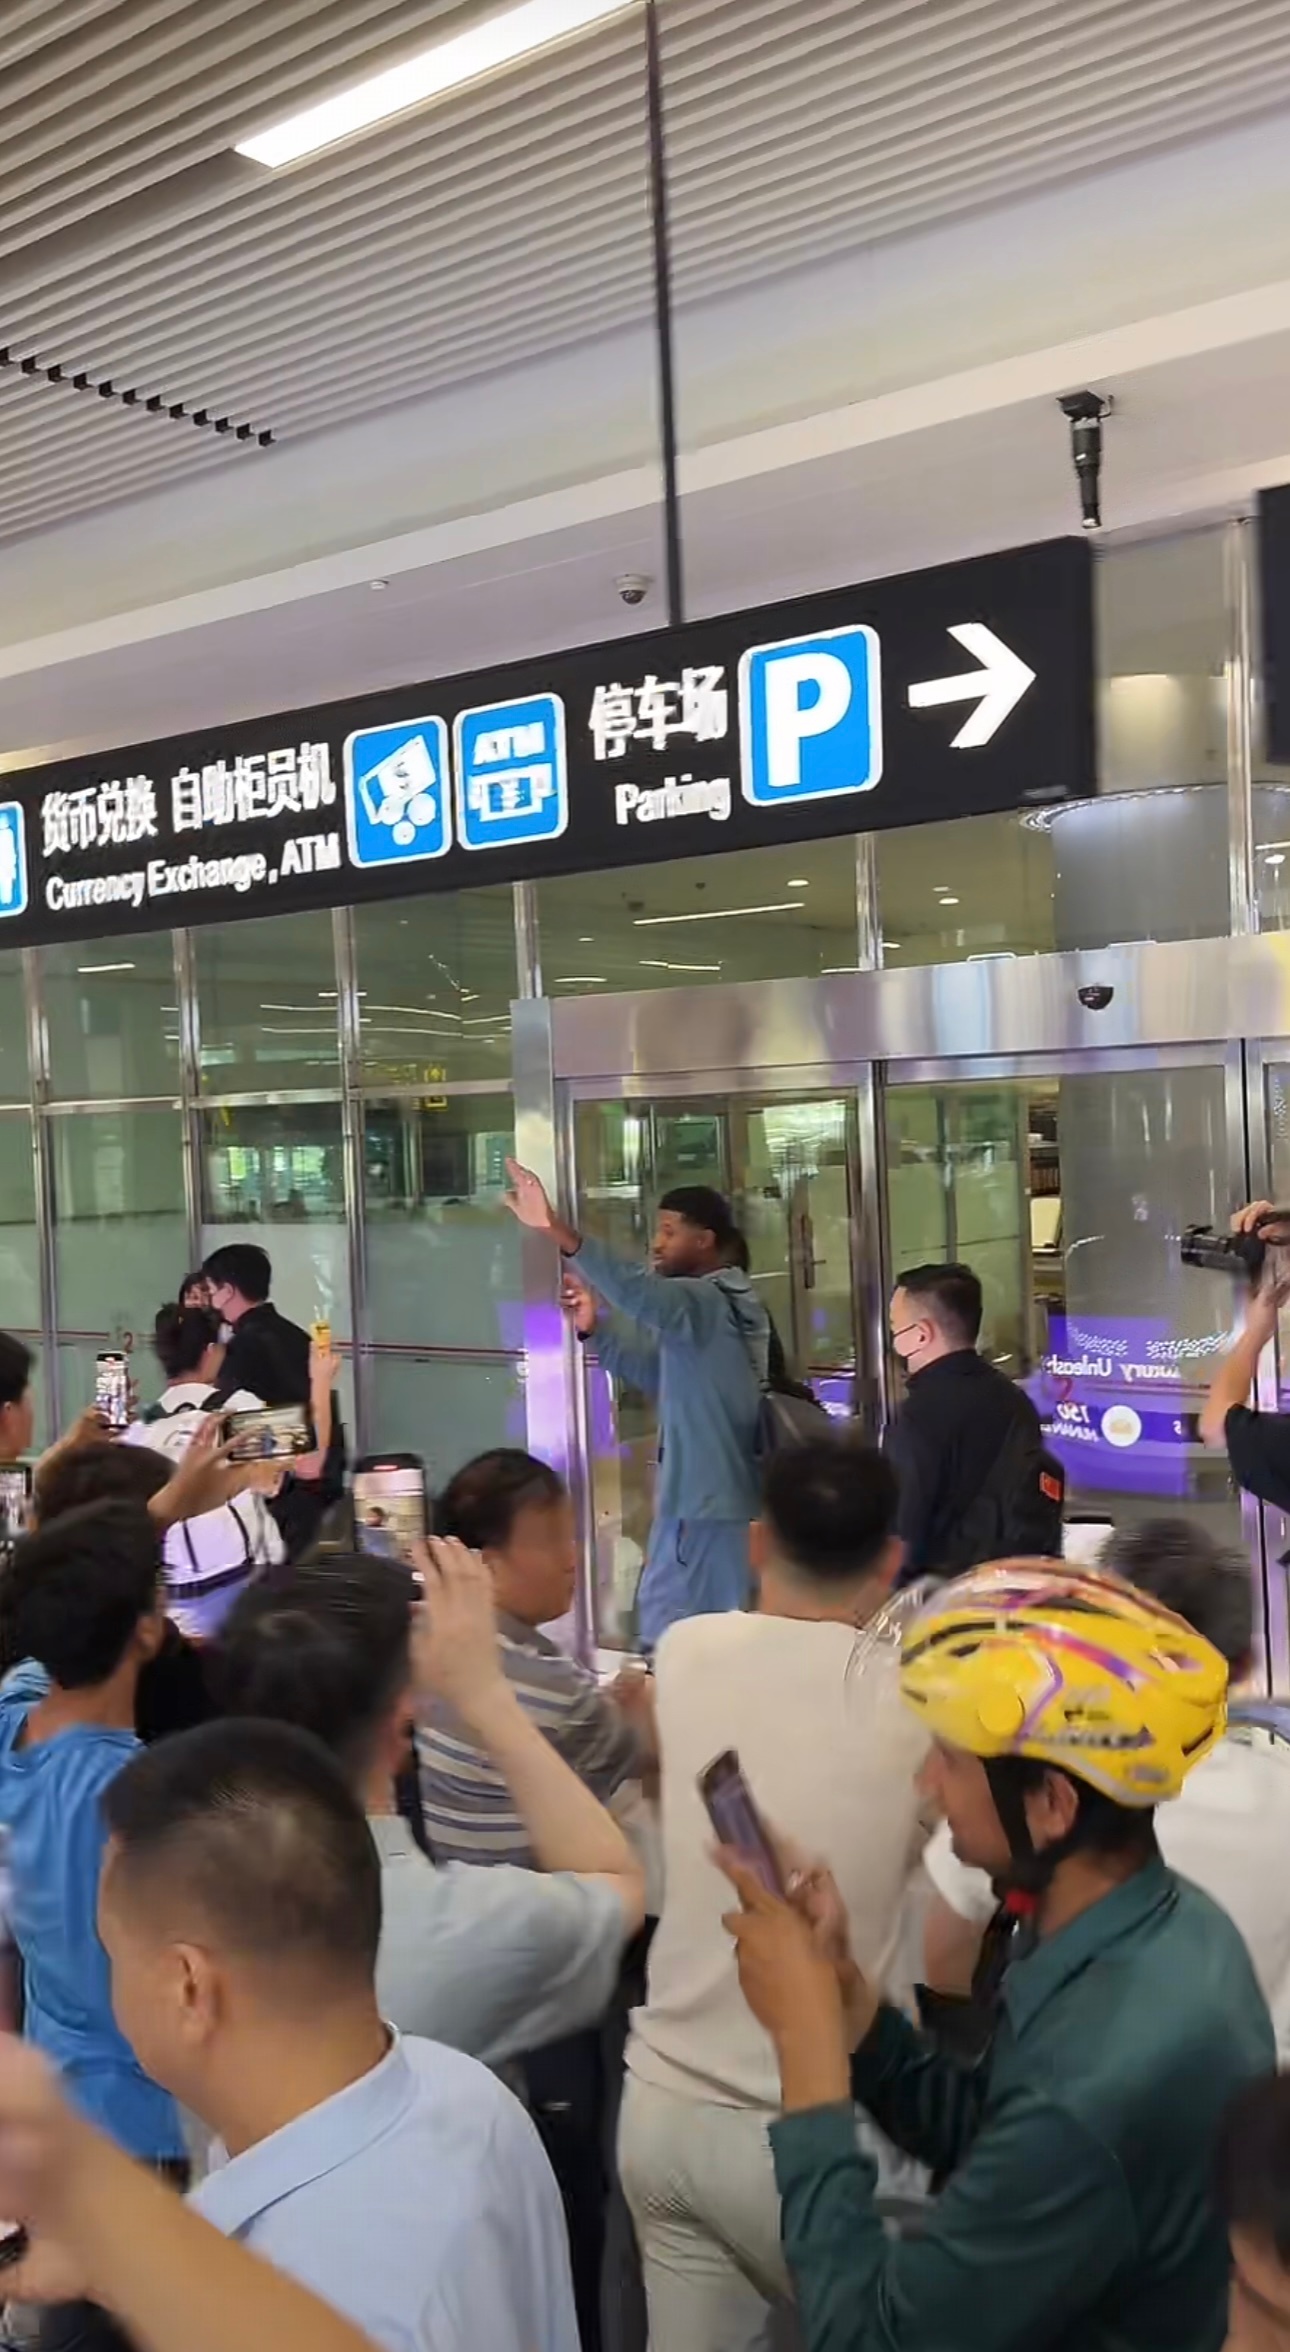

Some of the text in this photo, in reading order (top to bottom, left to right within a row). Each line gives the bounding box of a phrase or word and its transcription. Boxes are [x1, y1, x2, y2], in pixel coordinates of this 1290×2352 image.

[473, 721, 546, 765] ATM
[588, 665, 728, 761] 停车场
[764, 652, 852, 787] P
[614, 773, 731, 825] Parking
[46, 871, 145, 910] Currency
[280, 832, 341, 876] ATM
